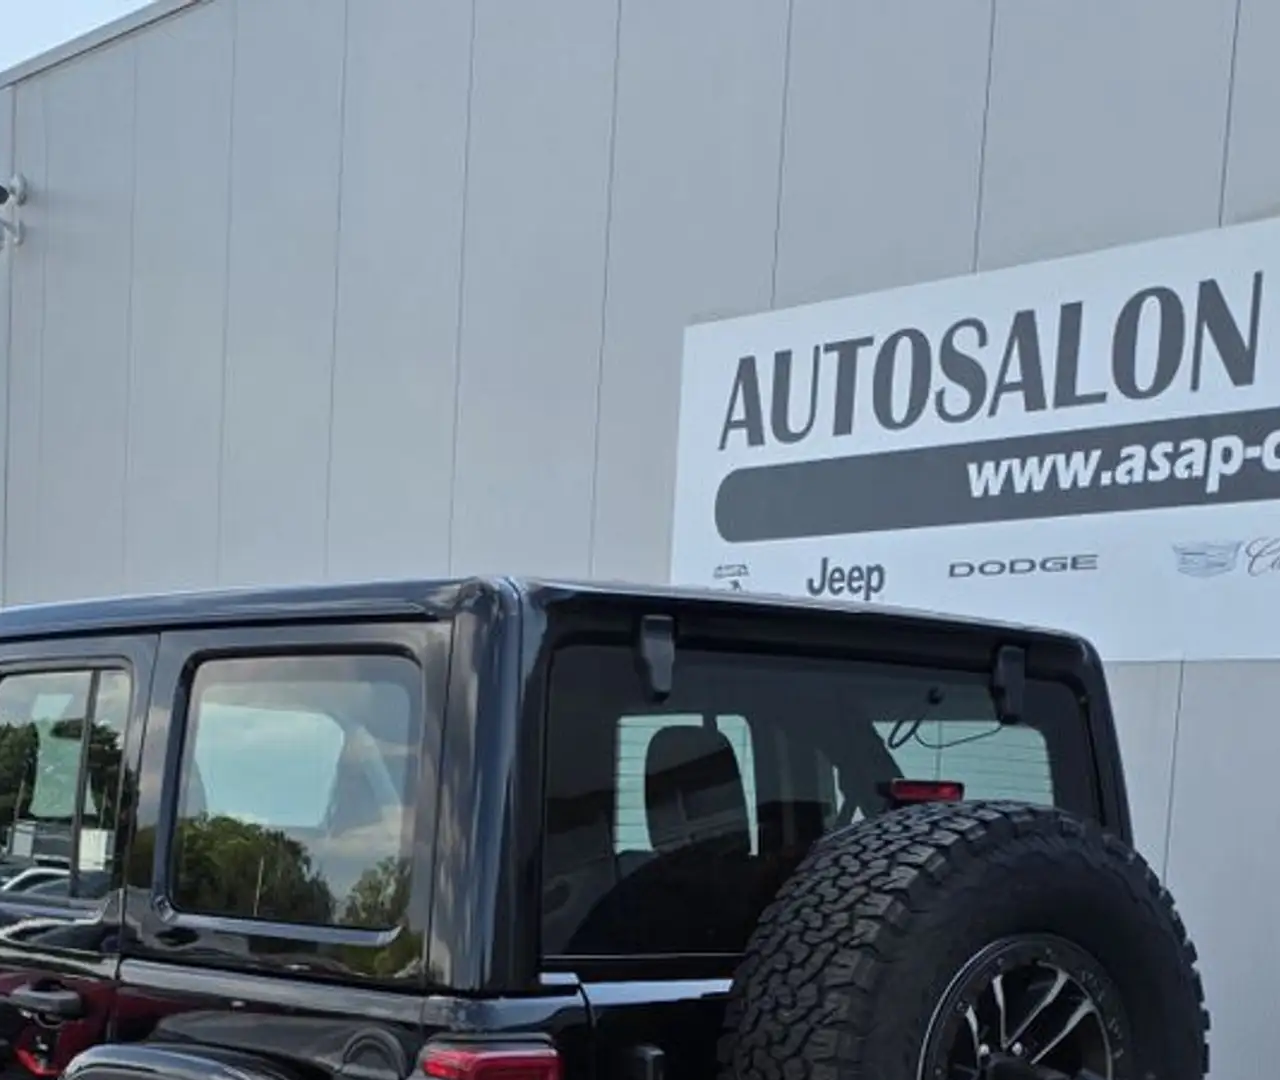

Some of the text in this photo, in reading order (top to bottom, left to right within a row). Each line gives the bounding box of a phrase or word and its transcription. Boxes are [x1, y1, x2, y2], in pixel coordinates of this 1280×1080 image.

[719, 271, 1263, 451] AUTOSALON
[806, 556, 885, 602] Jeep
[948, 554, 1099, 578] DODGE
